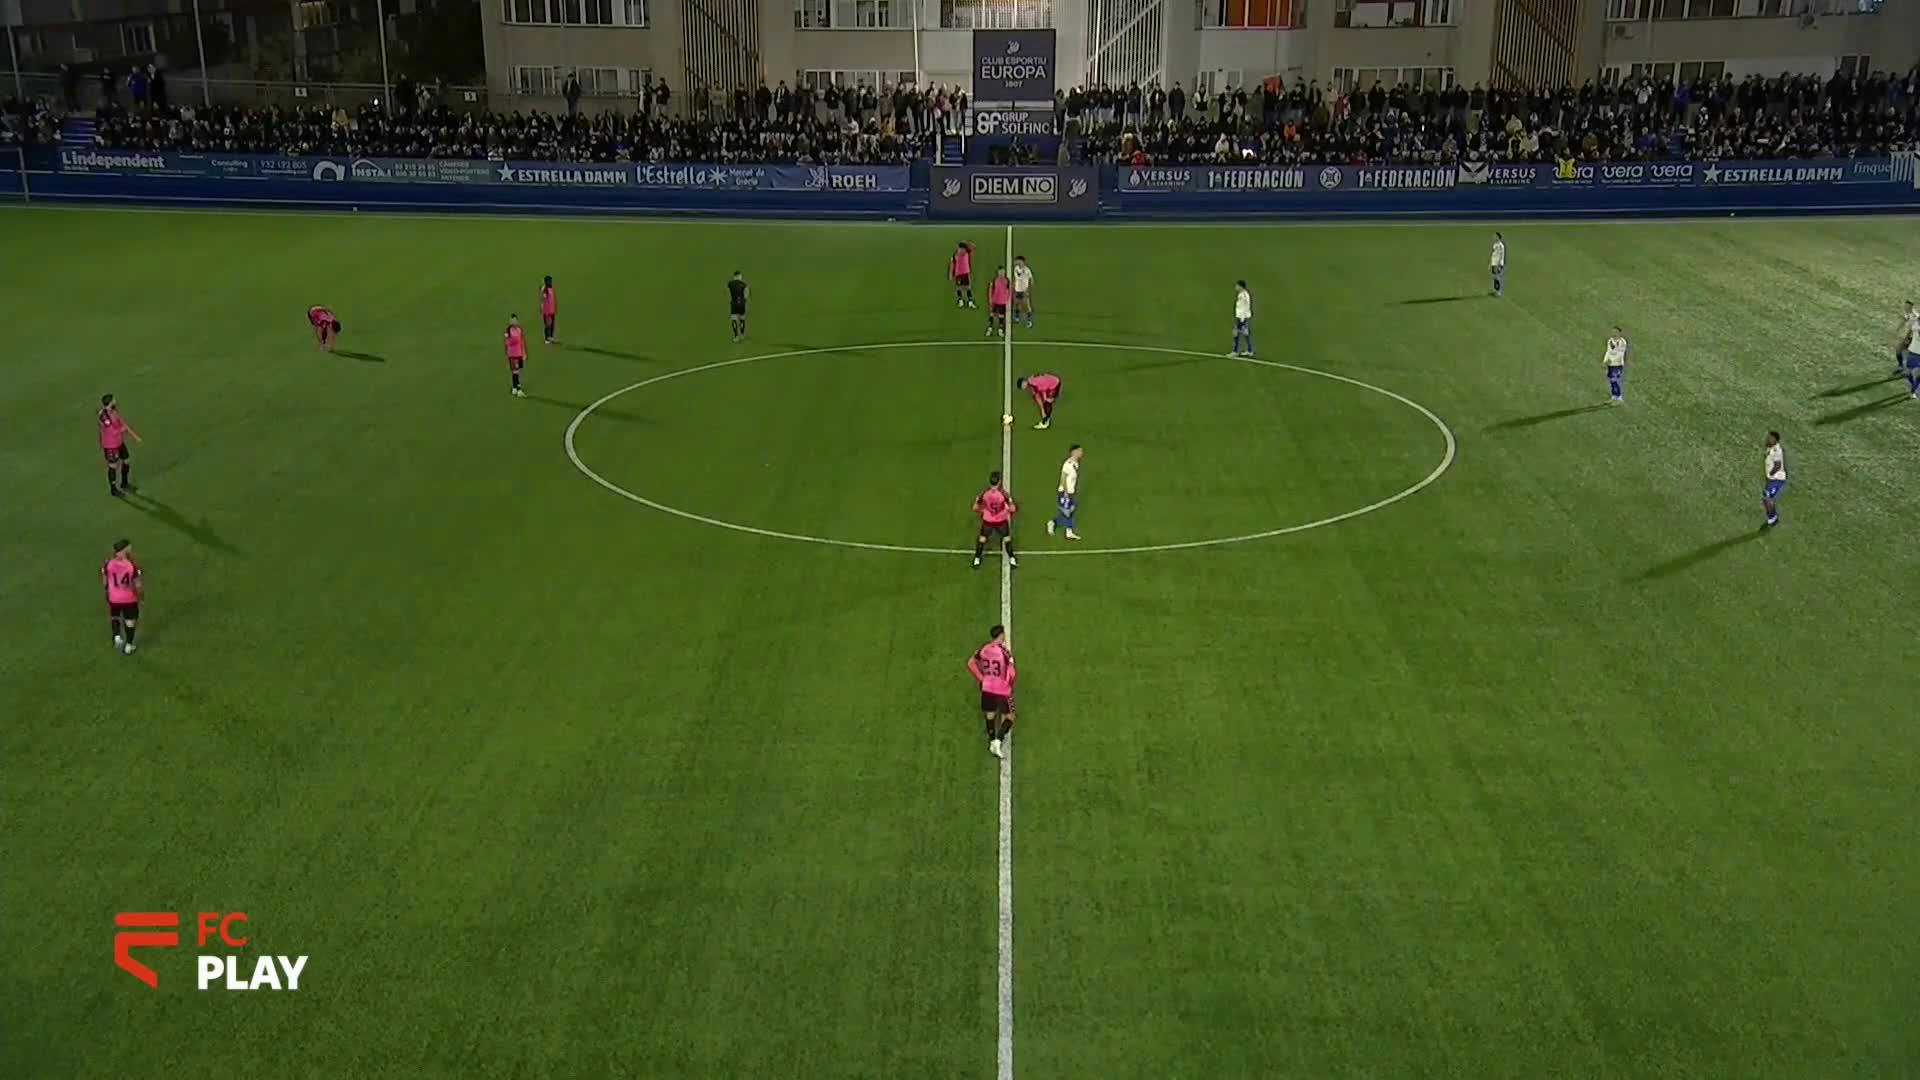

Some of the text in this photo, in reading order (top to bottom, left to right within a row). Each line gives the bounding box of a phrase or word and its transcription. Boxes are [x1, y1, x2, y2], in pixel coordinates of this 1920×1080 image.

[981, 56, 1047, 65] CLUB ESPORTIU
[981, 65, 1046, 80] EUROPA
[1002, 112, 1029, 122] GRUP
[518, 169, 627, 184] ESTRELLA DAMM
[1141, 170, 1191, 181] VERSUS
[1223, 166, 1304, 188] FEDERACIÓN
[1374, 166, 1456, 188] FEDERACIÓN
[1488, 168, 1536, 178] VERSUS
[1601, 165, 1643, 178] vera
[1650, 164, 1693, 177] vera
[1724, 167, 1843, 182] ESTRELLA DAMM
[831, 174, 877, 188] ROEH
[975, 178, 1053, 194] DIEM NO
[112, 571, 130, 588] 14
[983, 659, 1001, 678] 23
